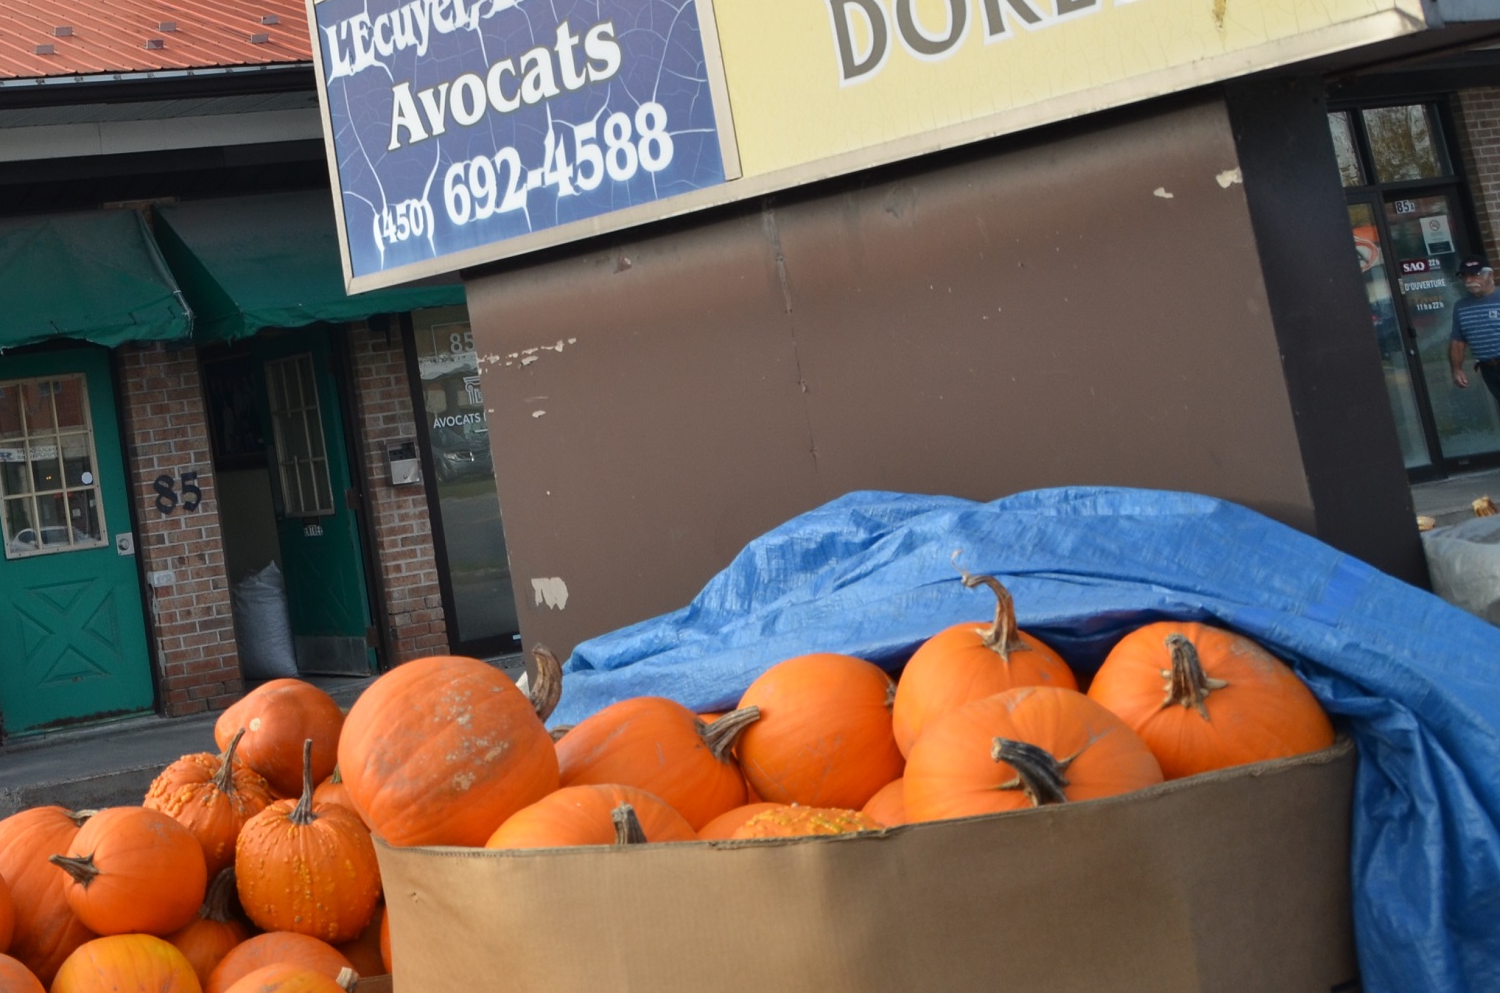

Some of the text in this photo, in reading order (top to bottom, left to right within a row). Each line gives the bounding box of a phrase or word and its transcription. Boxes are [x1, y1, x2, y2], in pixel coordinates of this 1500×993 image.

[387, 19, 622, 151] Avocats
[373, 102, 674, 252] (450) 692-4588
[1404, 279, 1446, 291] D'OUVERTURE
[434, 412, 481, 428] AVOCATS
[153, 471, 201, 515] 85
